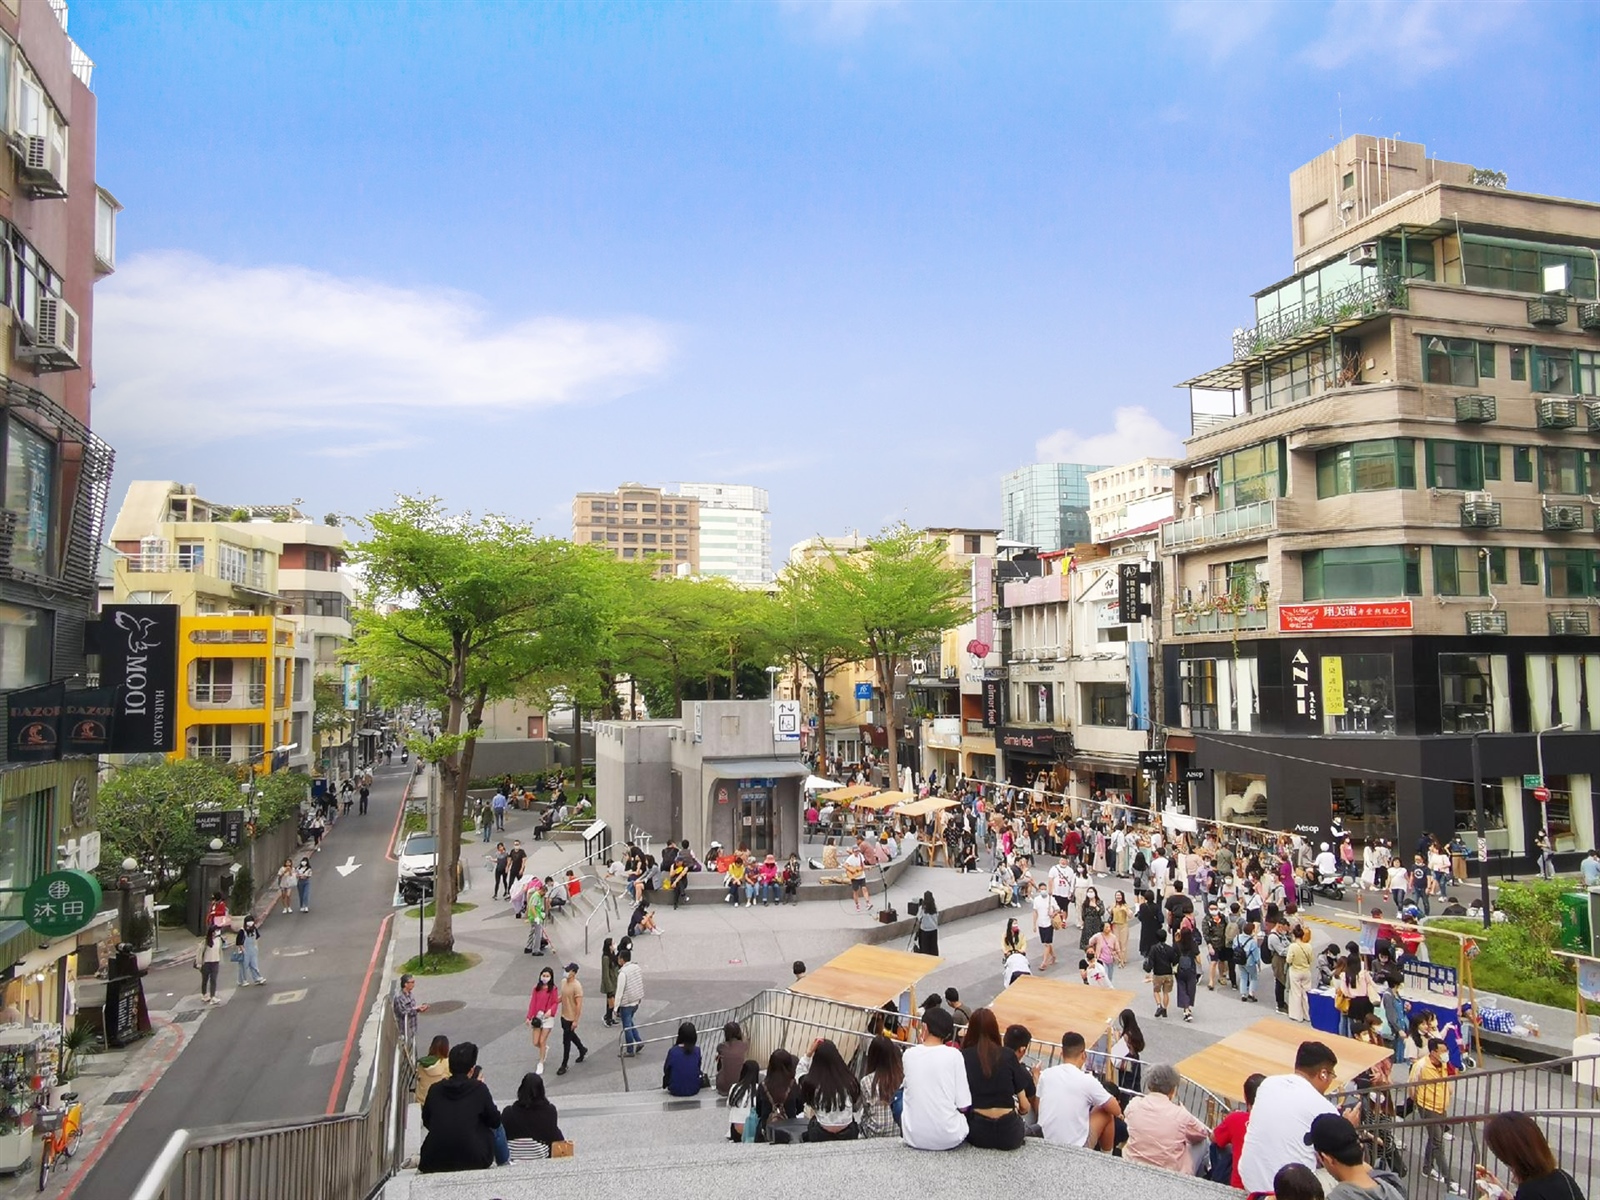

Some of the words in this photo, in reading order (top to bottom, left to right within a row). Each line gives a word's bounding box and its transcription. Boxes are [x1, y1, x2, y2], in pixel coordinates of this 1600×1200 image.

[125, 655, 148, 716] MOOI
[1292, 649, 1309, 714] ANTI
[66, 705, 115, 717] RAZOR
[987, 684, 997, 725] aimerfeel
[1309, 691, 1317, 720] SALON
[153, 690, 165, 746] HAIRSALON
[1003, 733, 1034, 748] aimerfeel
[1185, 771, 1204, 779] Aesop
[1294, 824, 1320, 834] Aesop
[33, 901, 84, 918] 沐田
